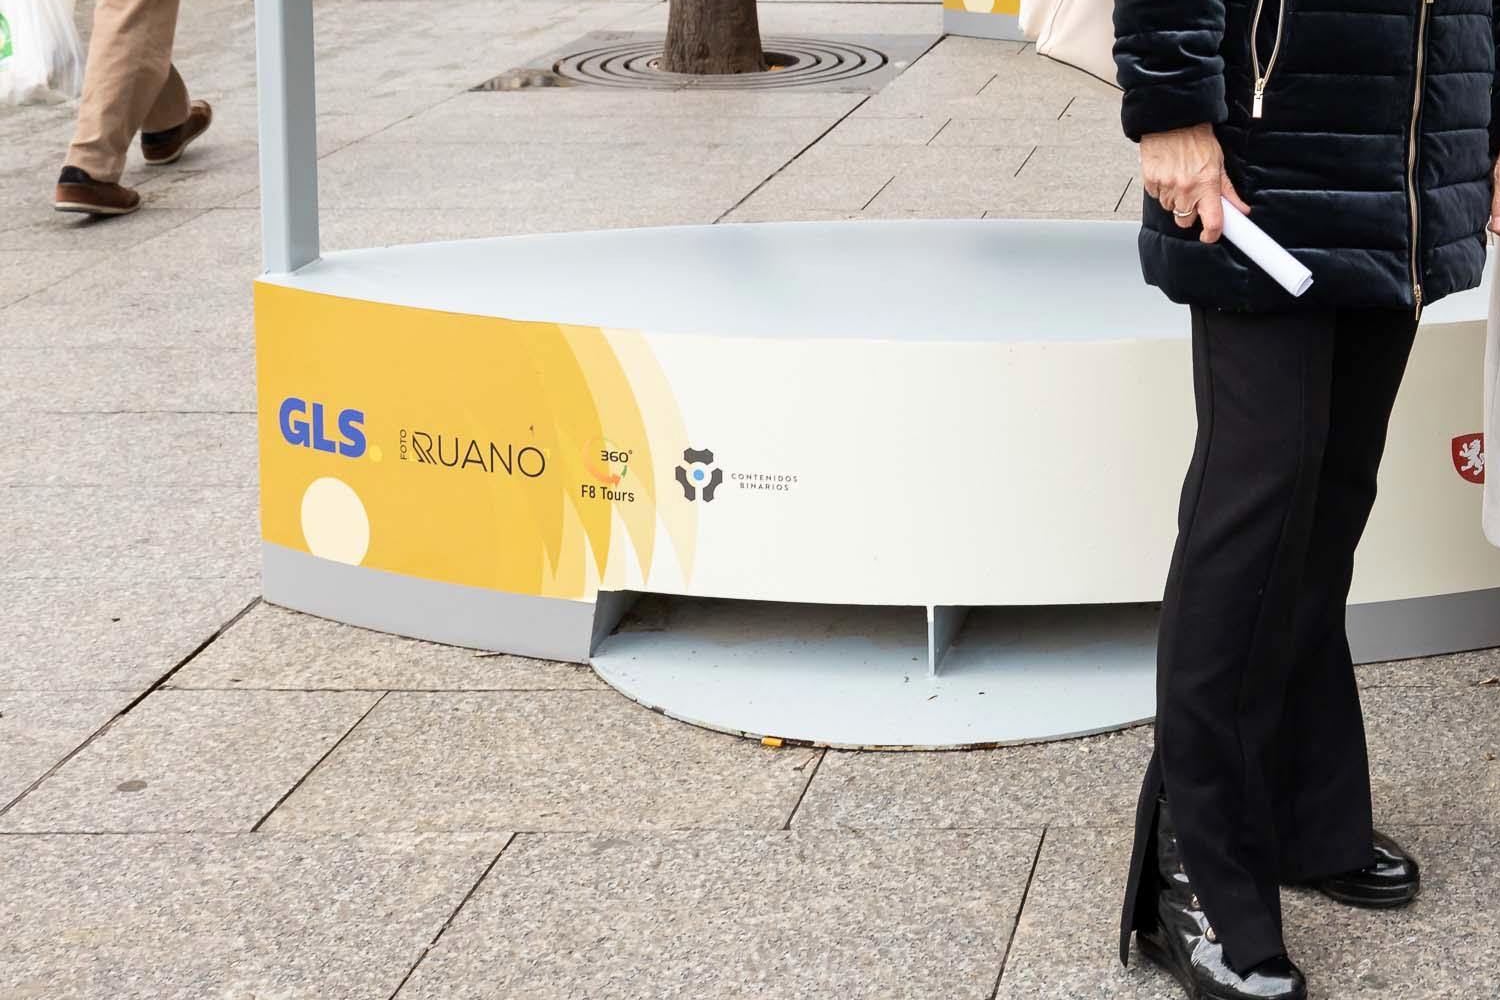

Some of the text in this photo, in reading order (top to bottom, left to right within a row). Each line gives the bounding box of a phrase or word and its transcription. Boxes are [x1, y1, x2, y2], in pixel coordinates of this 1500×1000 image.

[279, 397, 367, 458] GLS
[399, 429, 408, 460] FOTO
[412, 431, 546, 478] RUANO
[731, 473, 798, 483] CONTENIDOS
[740, 482, 789, 491] BINARIOS
[581, 484, 635, 503] F8 Tours
